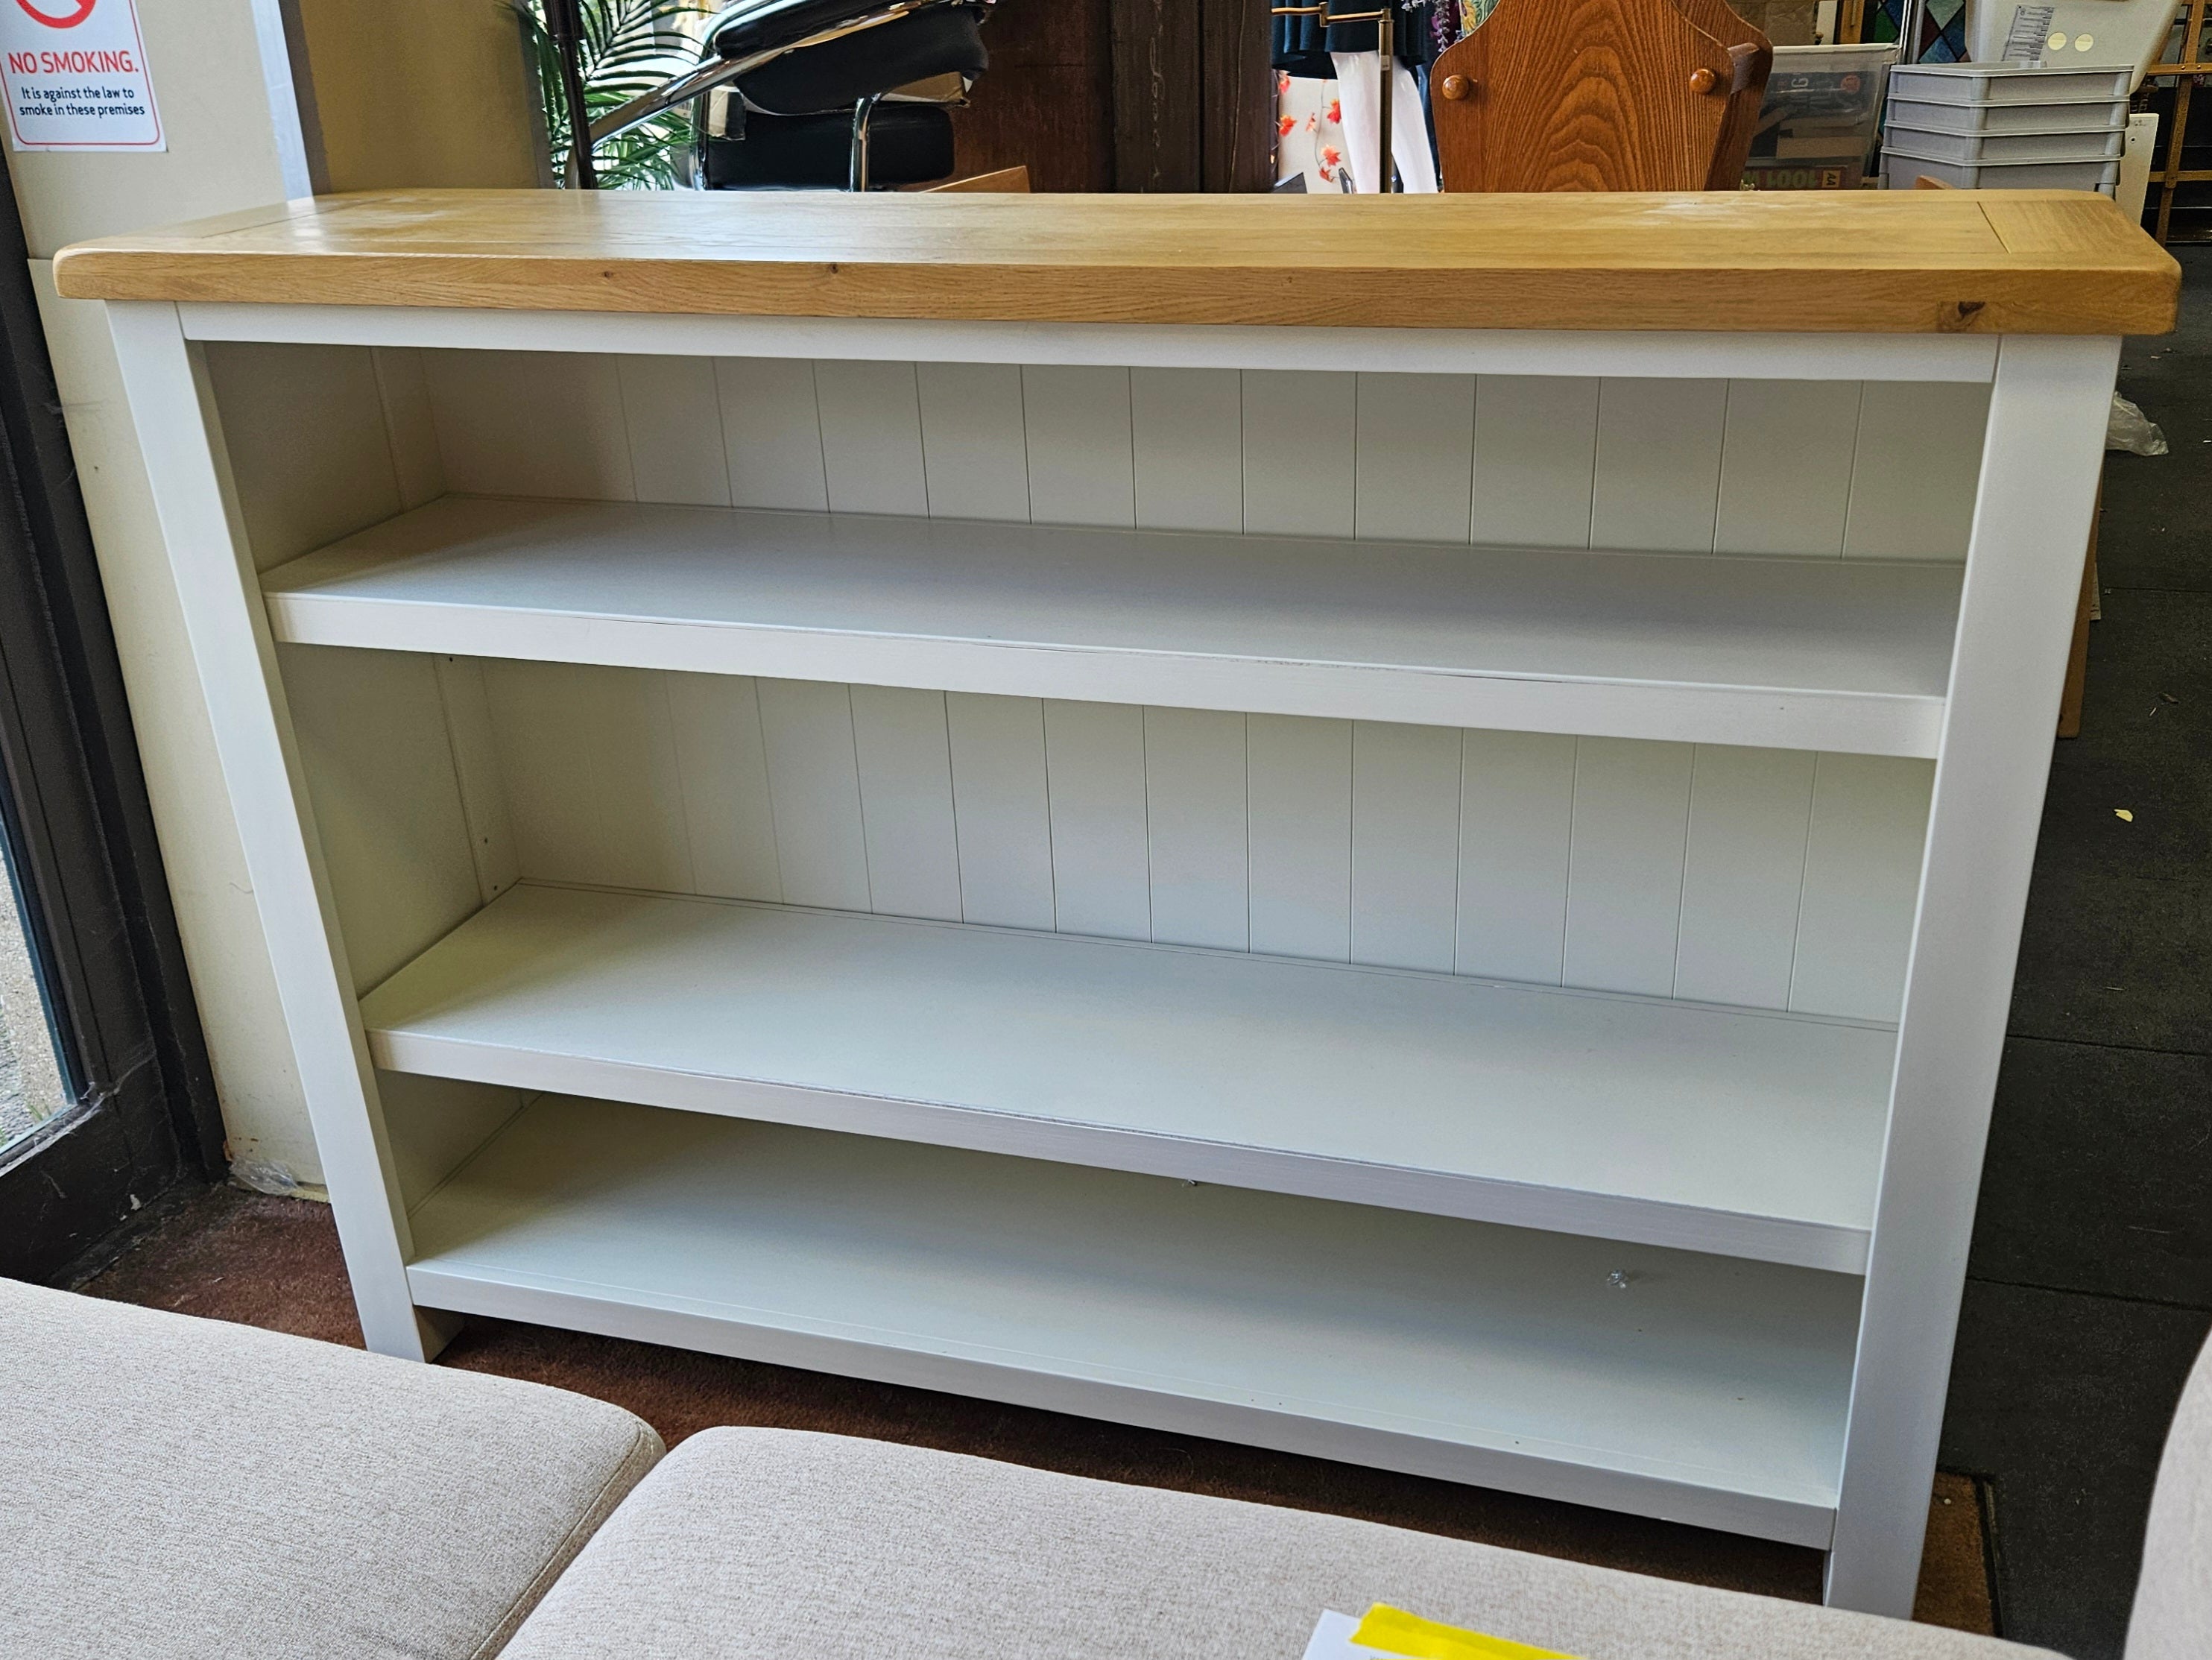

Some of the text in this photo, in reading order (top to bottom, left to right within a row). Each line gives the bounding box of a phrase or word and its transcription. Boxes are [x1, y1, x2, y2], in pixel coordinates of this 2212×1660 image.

[7, 50, 139, 74] NO SMOKING.
[21, 86, 135, 103] It is against the law to
[19, 103, 145, 119] smoke in these premises
